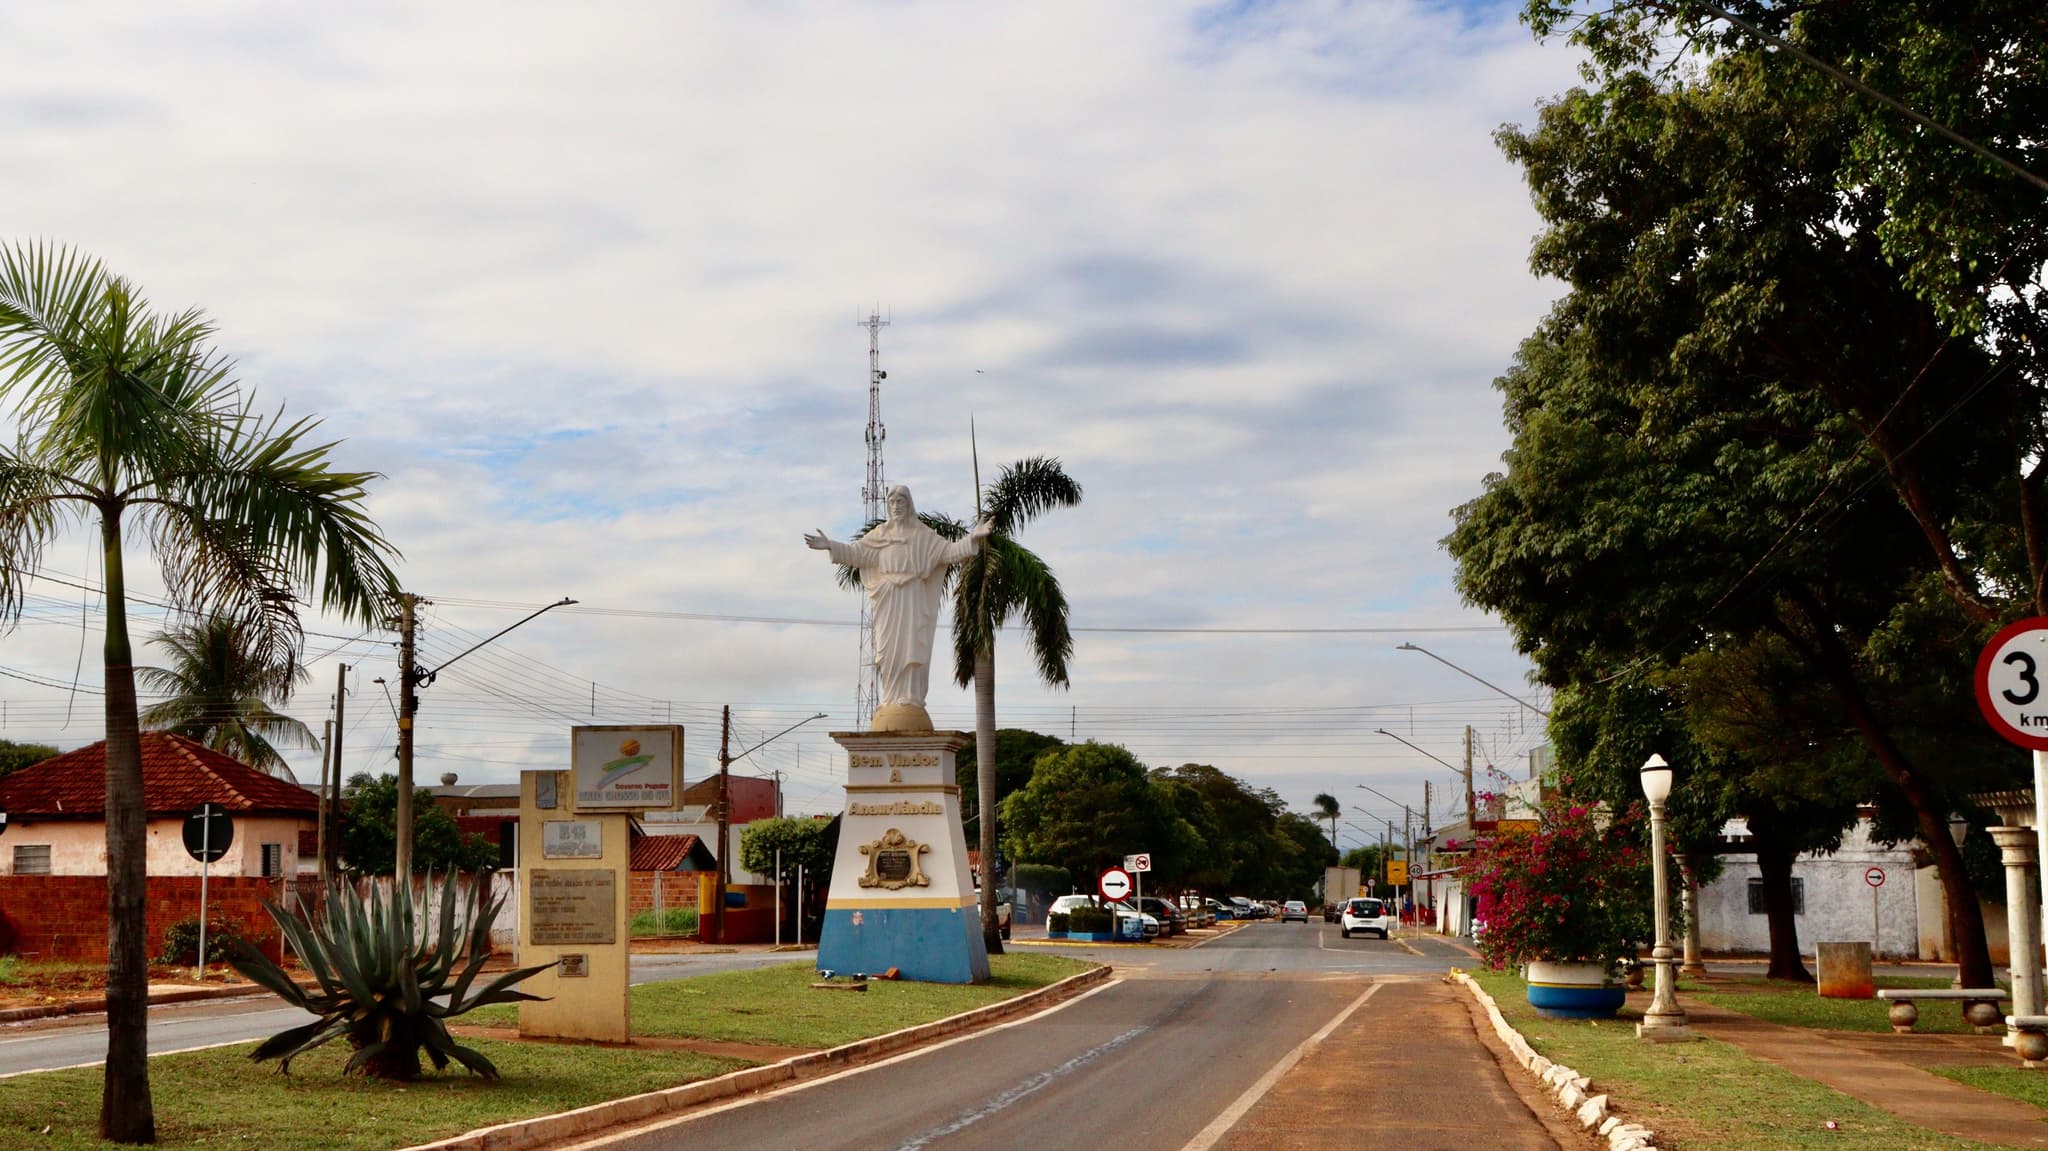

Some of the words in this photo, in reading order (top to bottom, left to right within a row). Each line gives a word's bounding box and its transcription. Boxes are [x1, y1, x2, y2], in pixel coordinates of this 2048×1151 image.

[850, 754, 883, 768] Bem
[887, 752, 939, 768] Vindos
[889, 768, 904, 783] A
